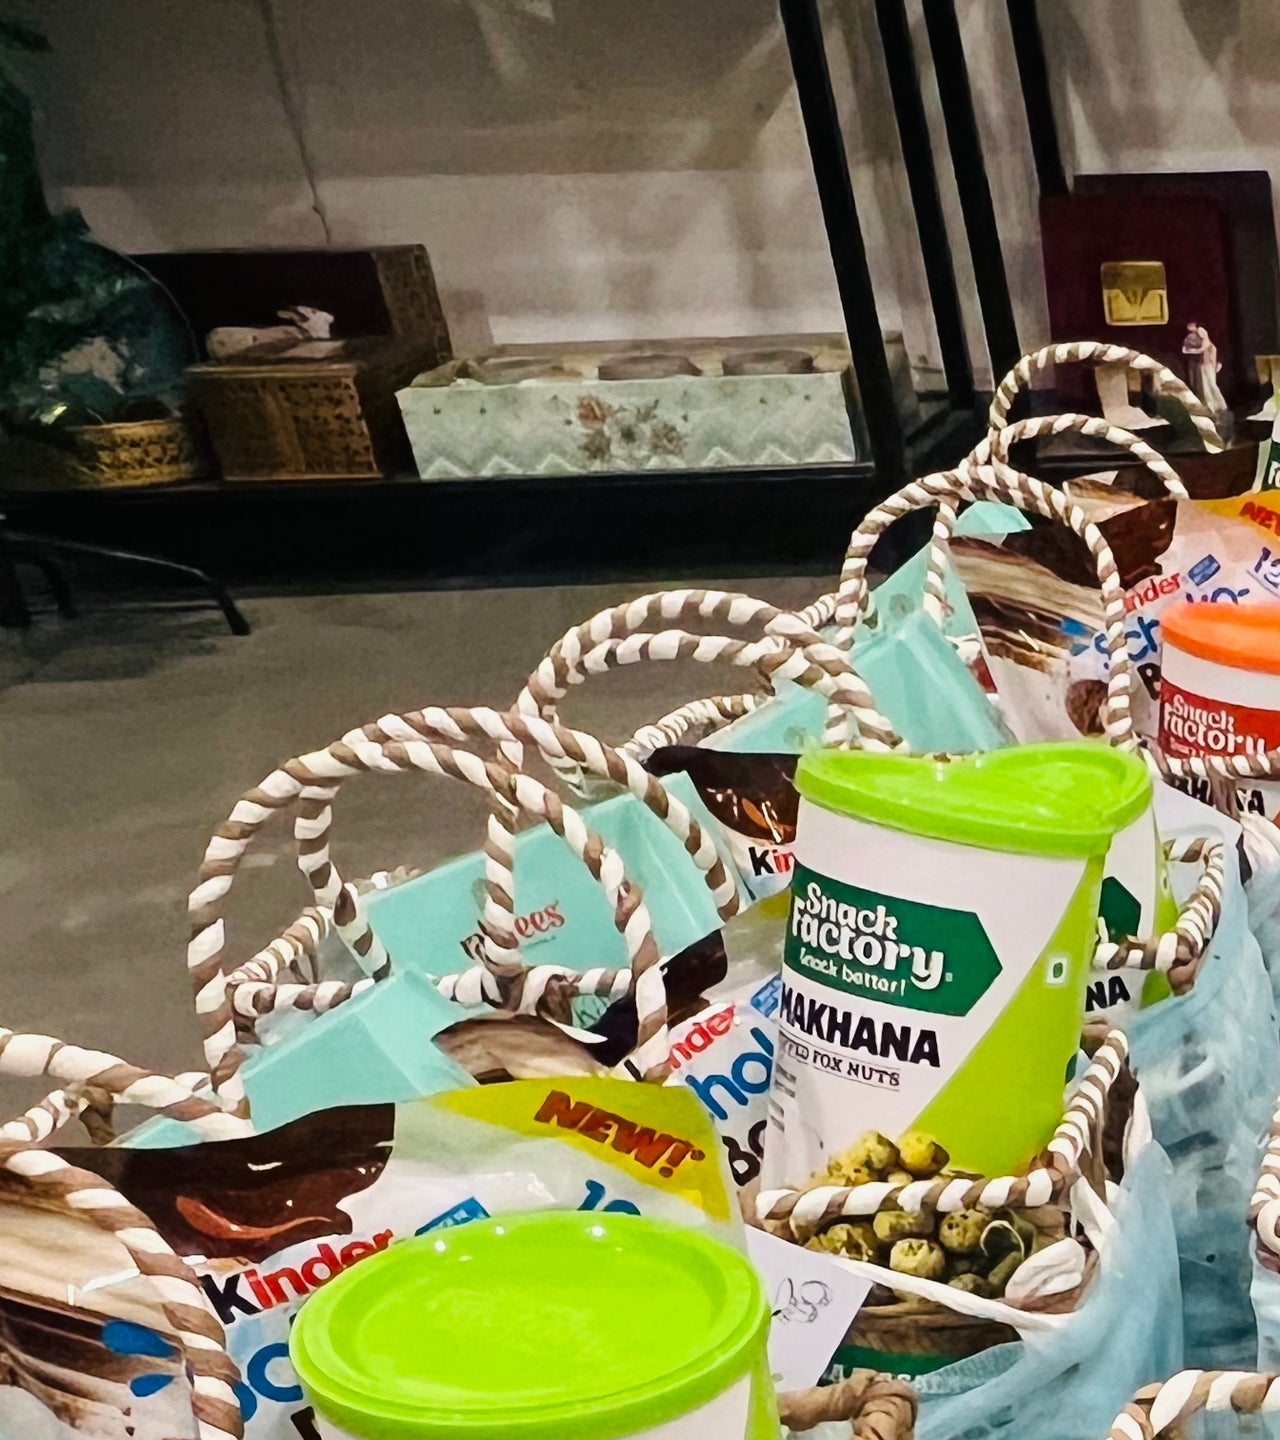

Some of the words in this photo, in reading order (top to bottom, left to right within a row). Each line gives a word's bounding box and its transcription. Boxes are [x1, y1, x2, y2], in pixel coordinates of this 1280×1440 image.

[1172, 694, 1235, 733] Snack
[792, 896, 944, 990] Factory
[806, 882, 898, 941] Snack
[533, 1089, 706, 1179] NEW!
[200, 1229, 394, 1324] Kinder
